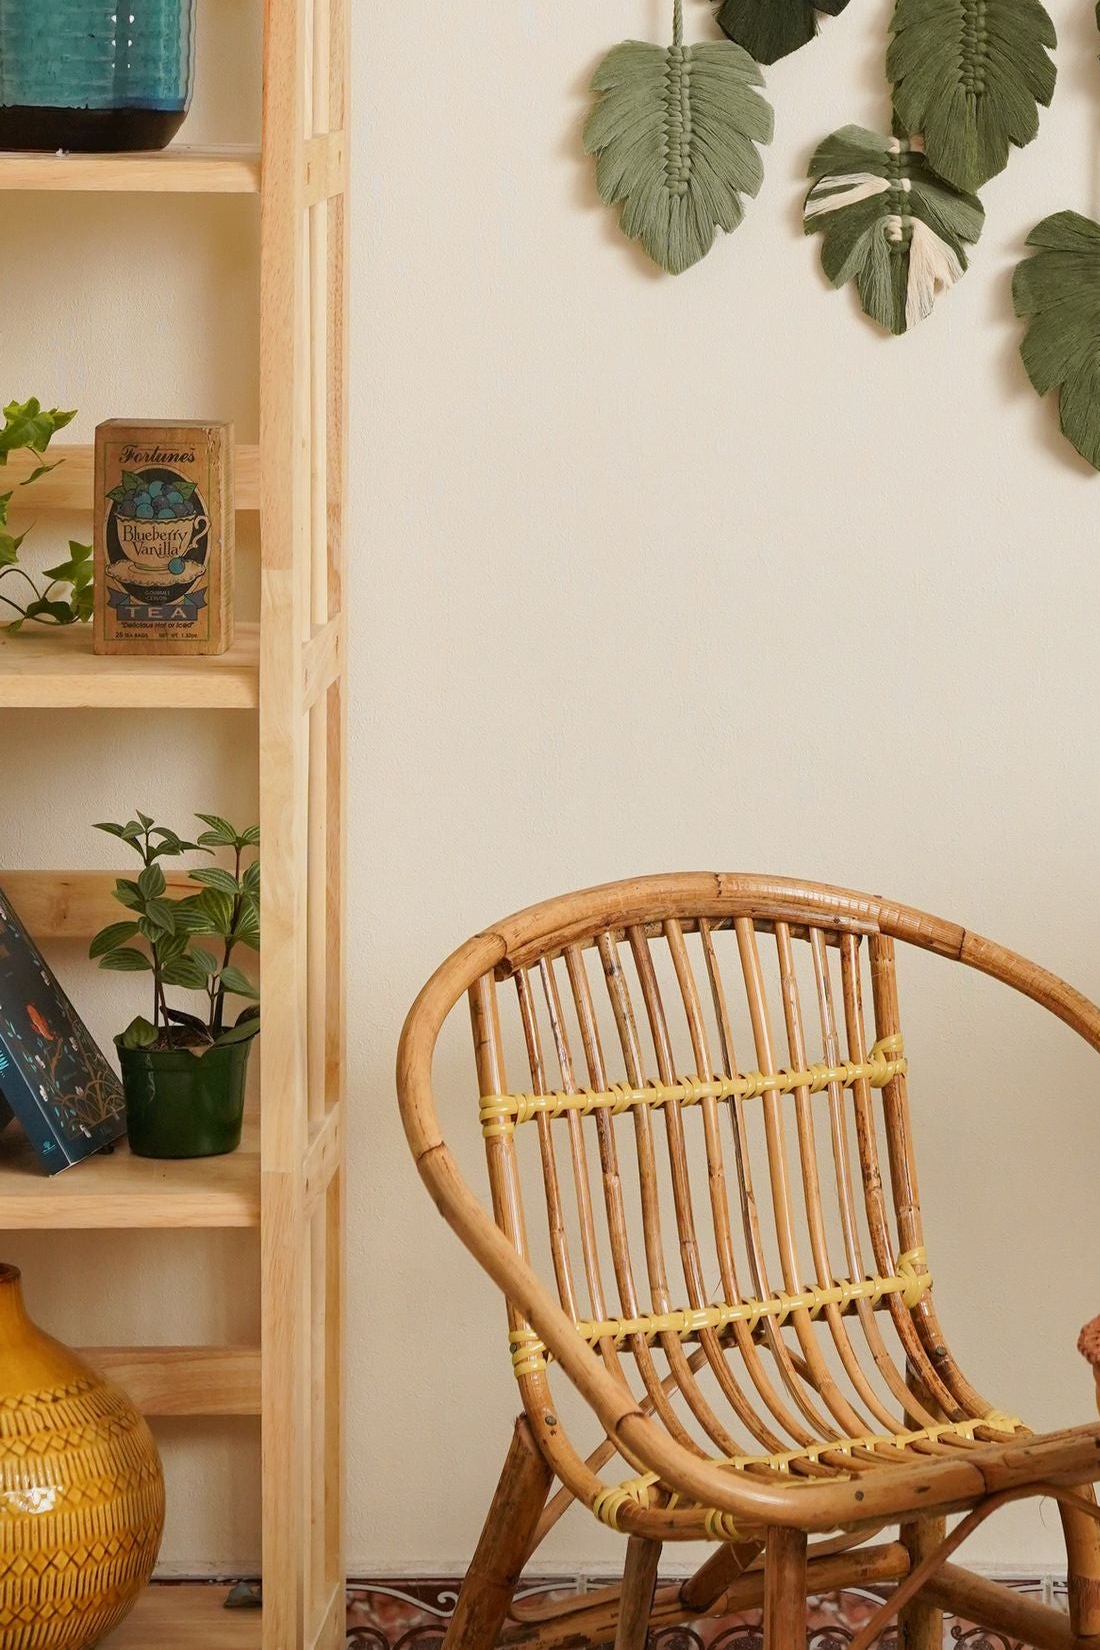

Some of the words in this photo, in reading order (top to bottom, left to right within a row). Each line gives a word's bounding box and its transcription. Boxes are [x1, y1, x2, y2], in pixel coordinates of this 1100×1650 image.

[123, 525, 188, 548] Blueberry
[132, 540, 180, 558] Vanilla
[124, 606, 187, 619] TEA
